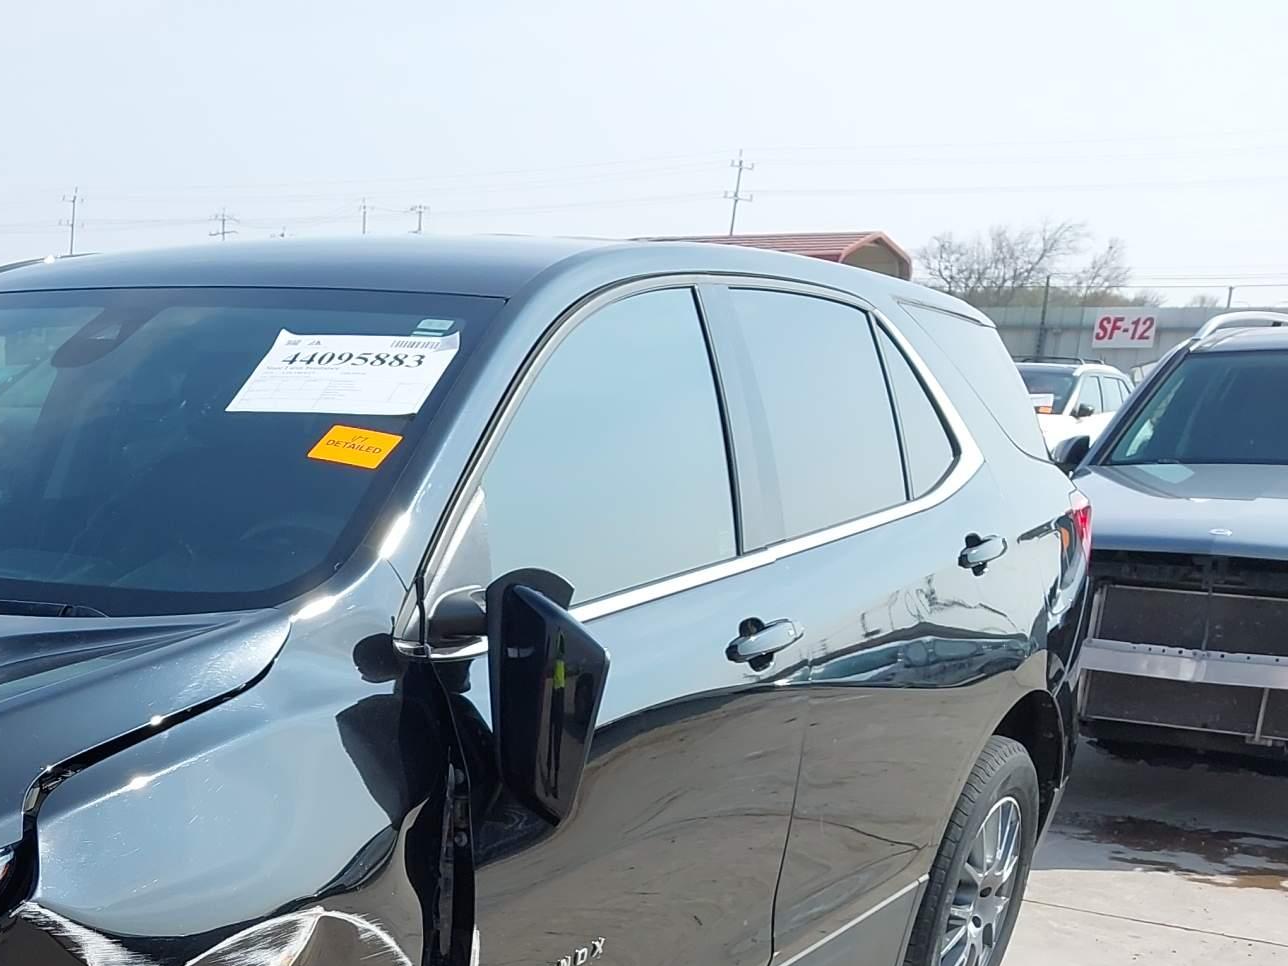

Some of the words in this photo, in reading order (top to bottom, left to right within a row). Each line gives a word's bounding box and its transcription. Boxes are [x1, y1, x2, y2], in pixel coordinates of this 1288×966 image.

[1095, 316, 1155, 341] SF-12
[281, 351, 427, 368] 44095883
[325, 439, 382, 455] DETAILED
